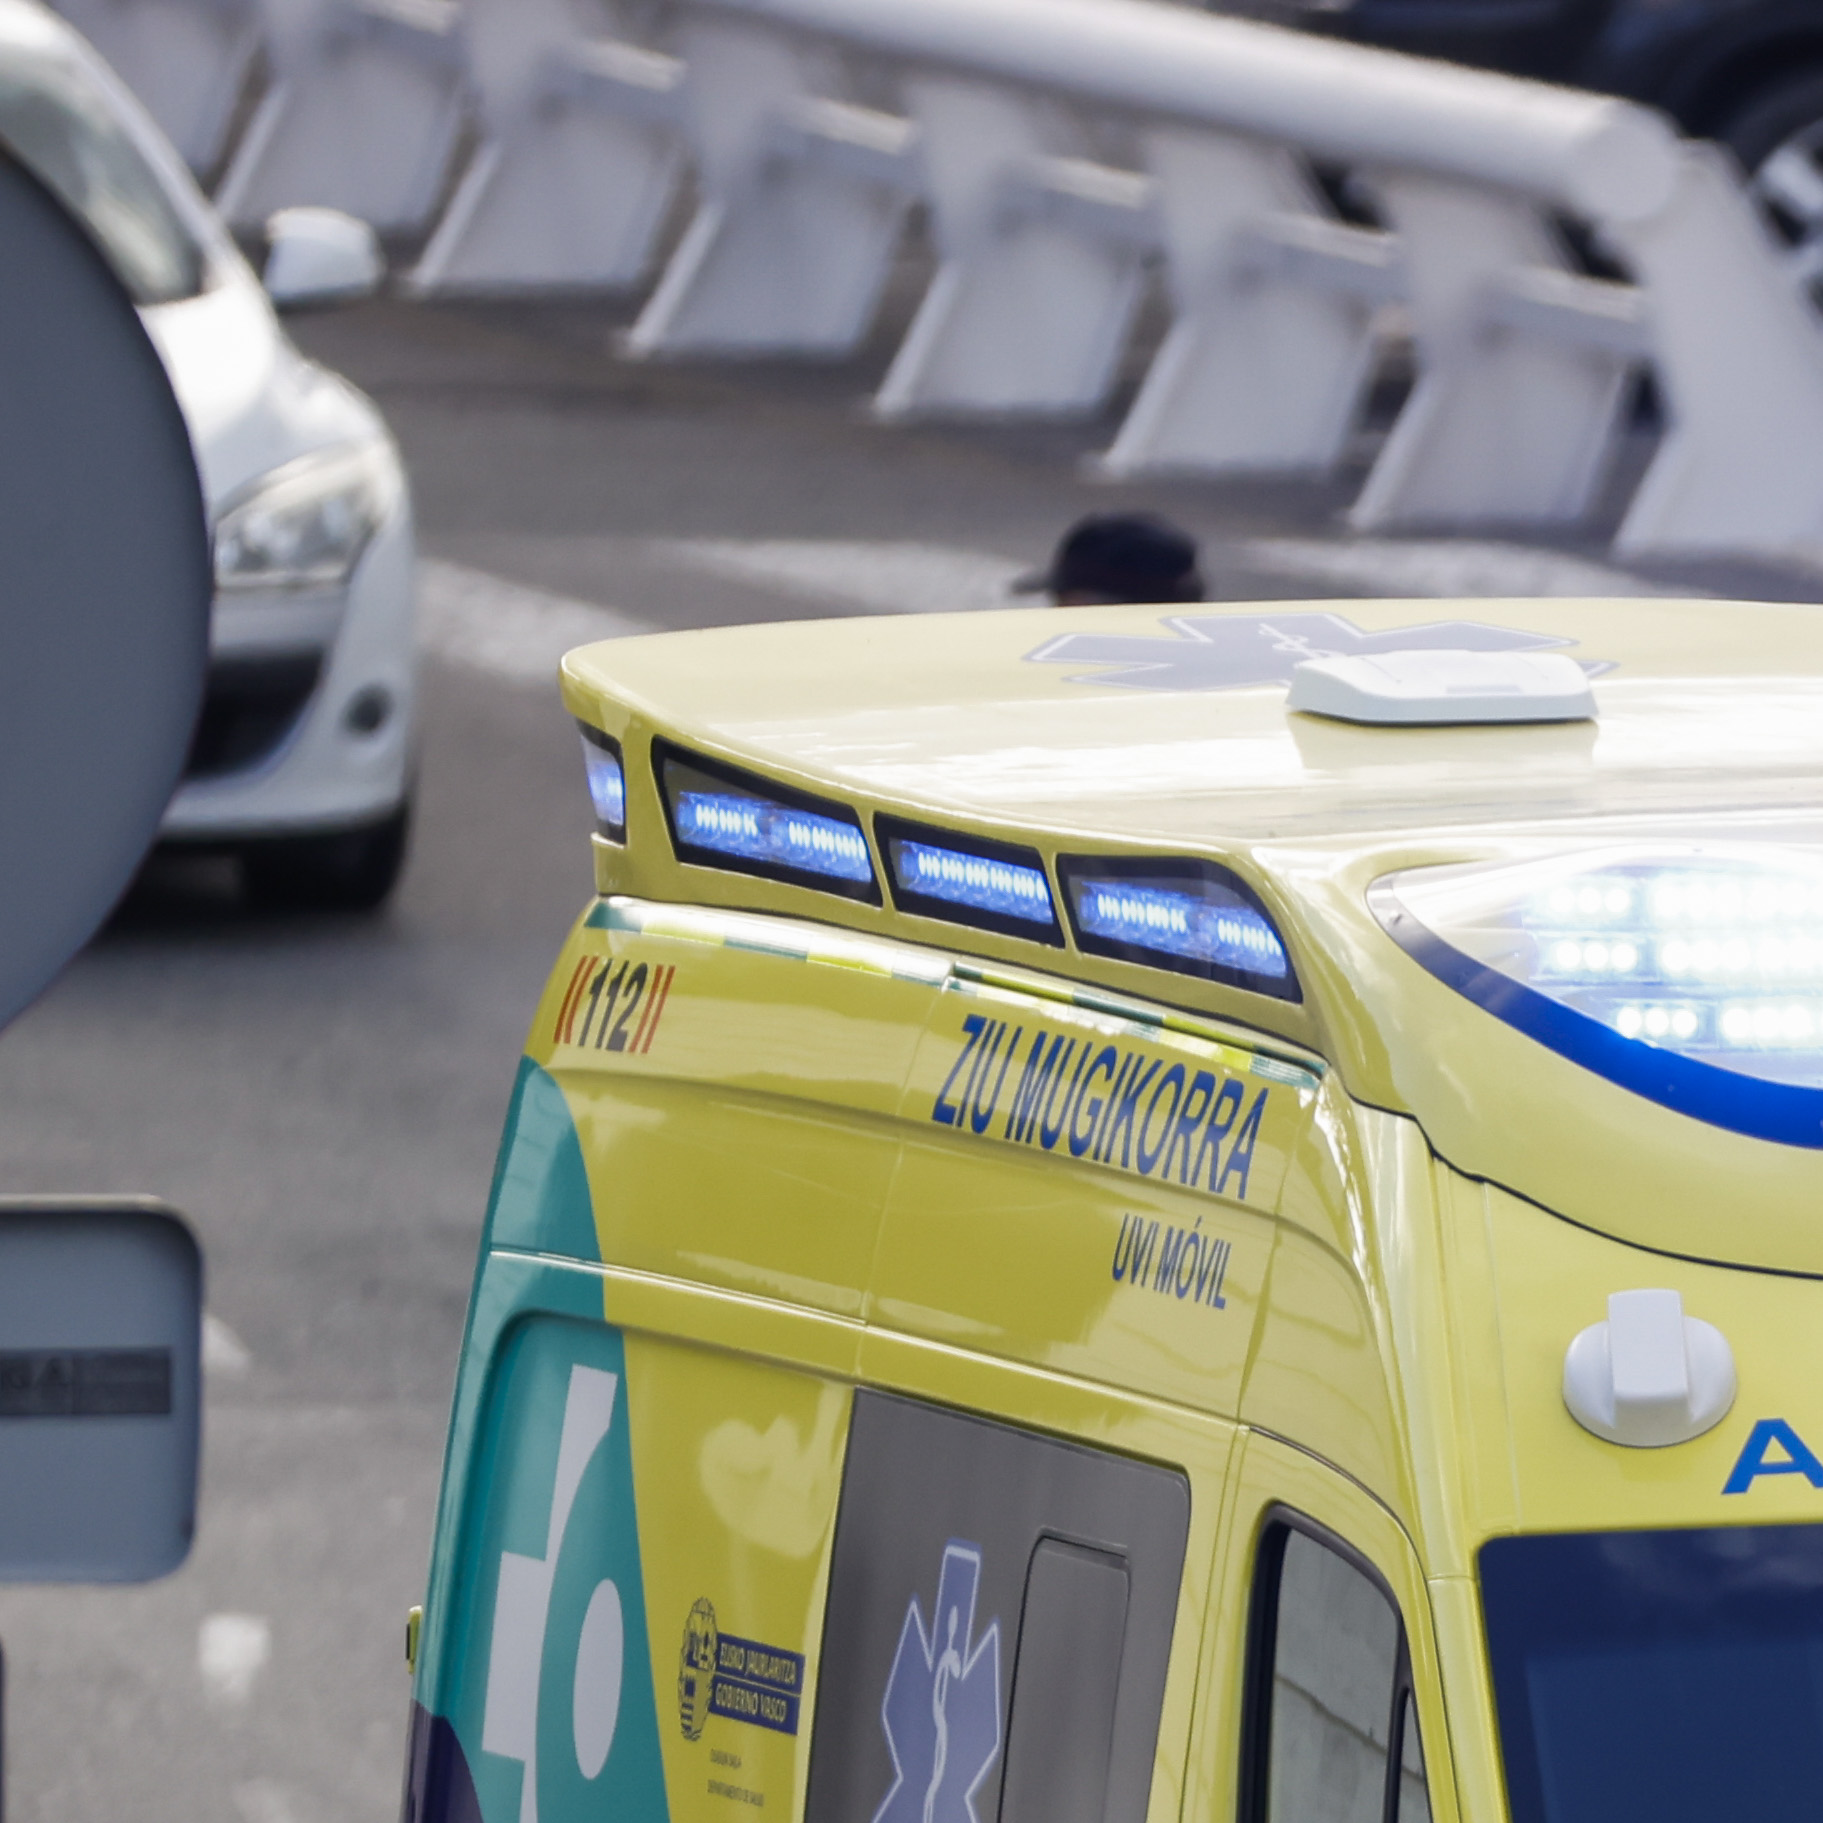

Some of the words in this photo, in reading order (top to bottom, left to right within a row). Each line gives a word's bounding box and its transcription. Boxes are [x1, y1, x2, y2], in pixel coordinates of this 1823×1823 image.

[931, 1013, 1023, 1135] ZIU
[1005, 1030, 1272, 1201] MUGIKORRA
[1112, 1213, 1160, 1288] UVI
[1153, 1215, 1231, 1310] MÓVIL
